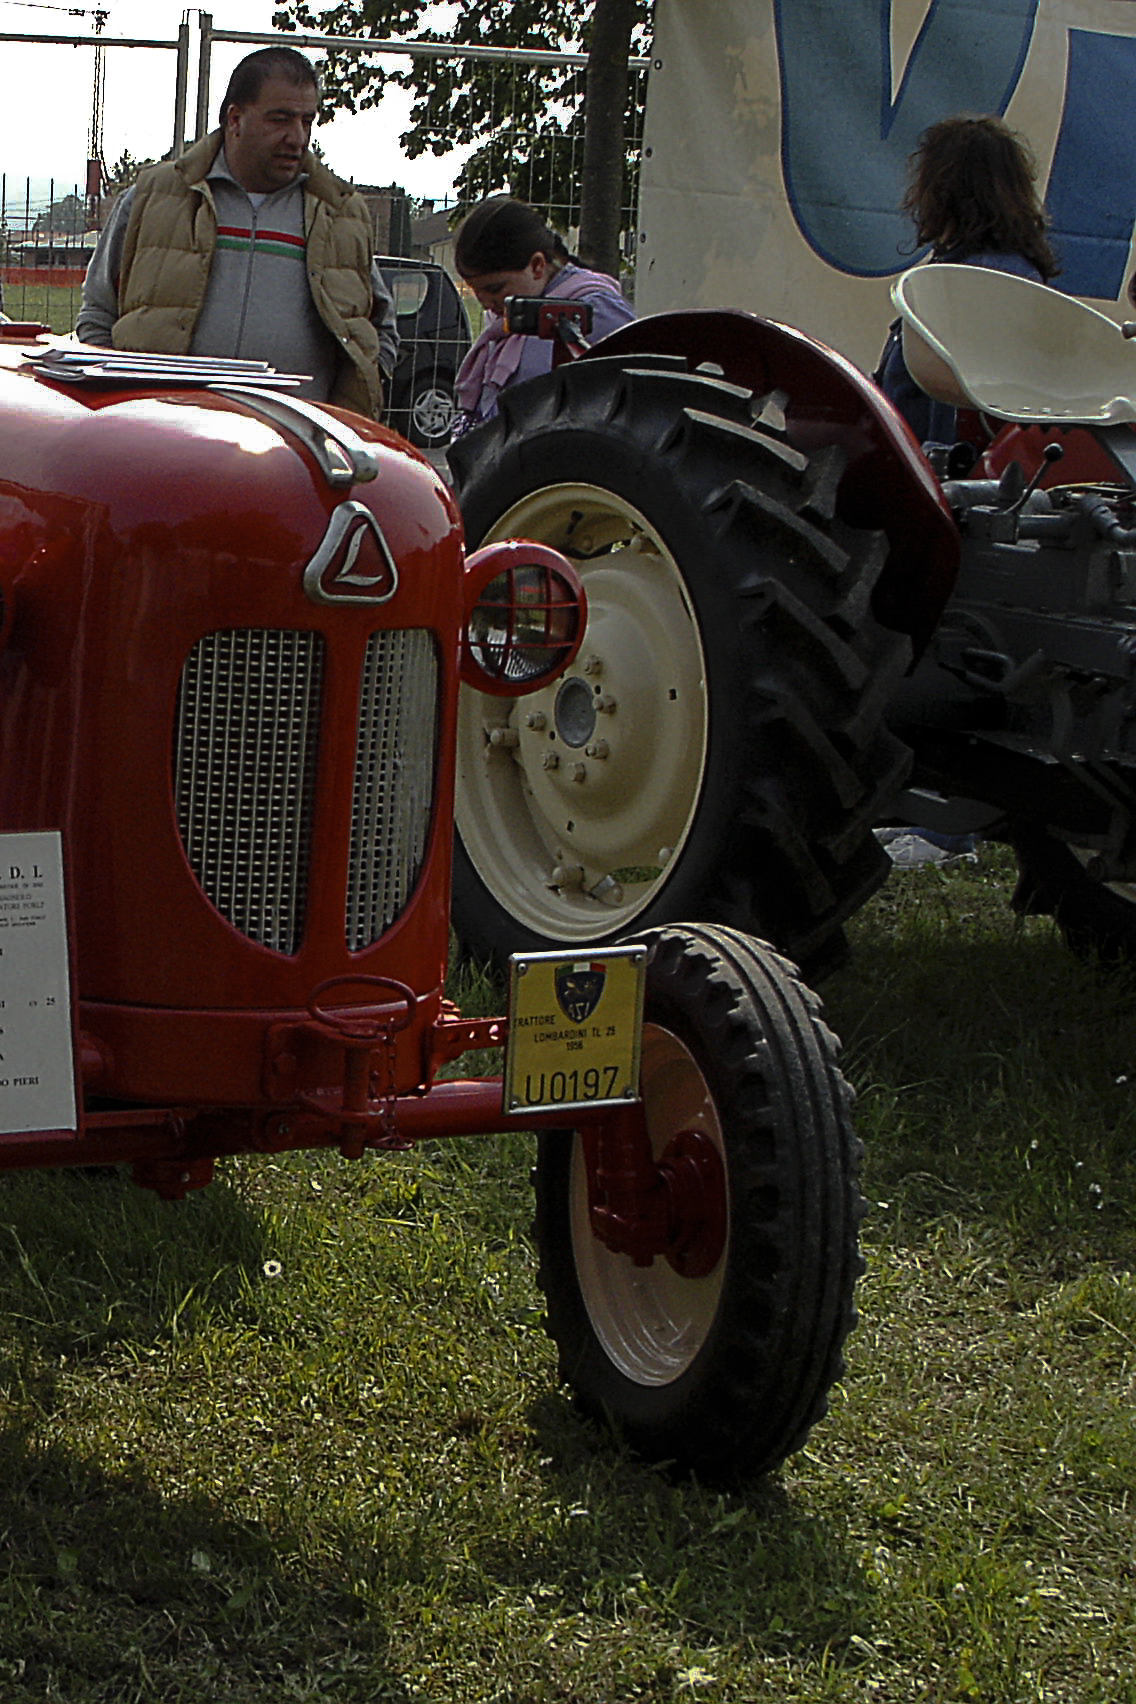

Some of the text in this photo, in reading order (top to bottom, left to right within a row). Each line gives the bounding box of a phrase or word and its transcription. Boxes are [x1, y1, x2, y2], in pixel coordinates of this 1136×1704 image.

[10, 866, 24, 879] D.
[33, 865, 43, 878] I.
[46, 997, 56, 1006] 25
[534, 1029, 587, 1043] LOMBARDINI
[592, 1027, 601, 1037] TL
[13, 1076, 39, 1087] PIERI
